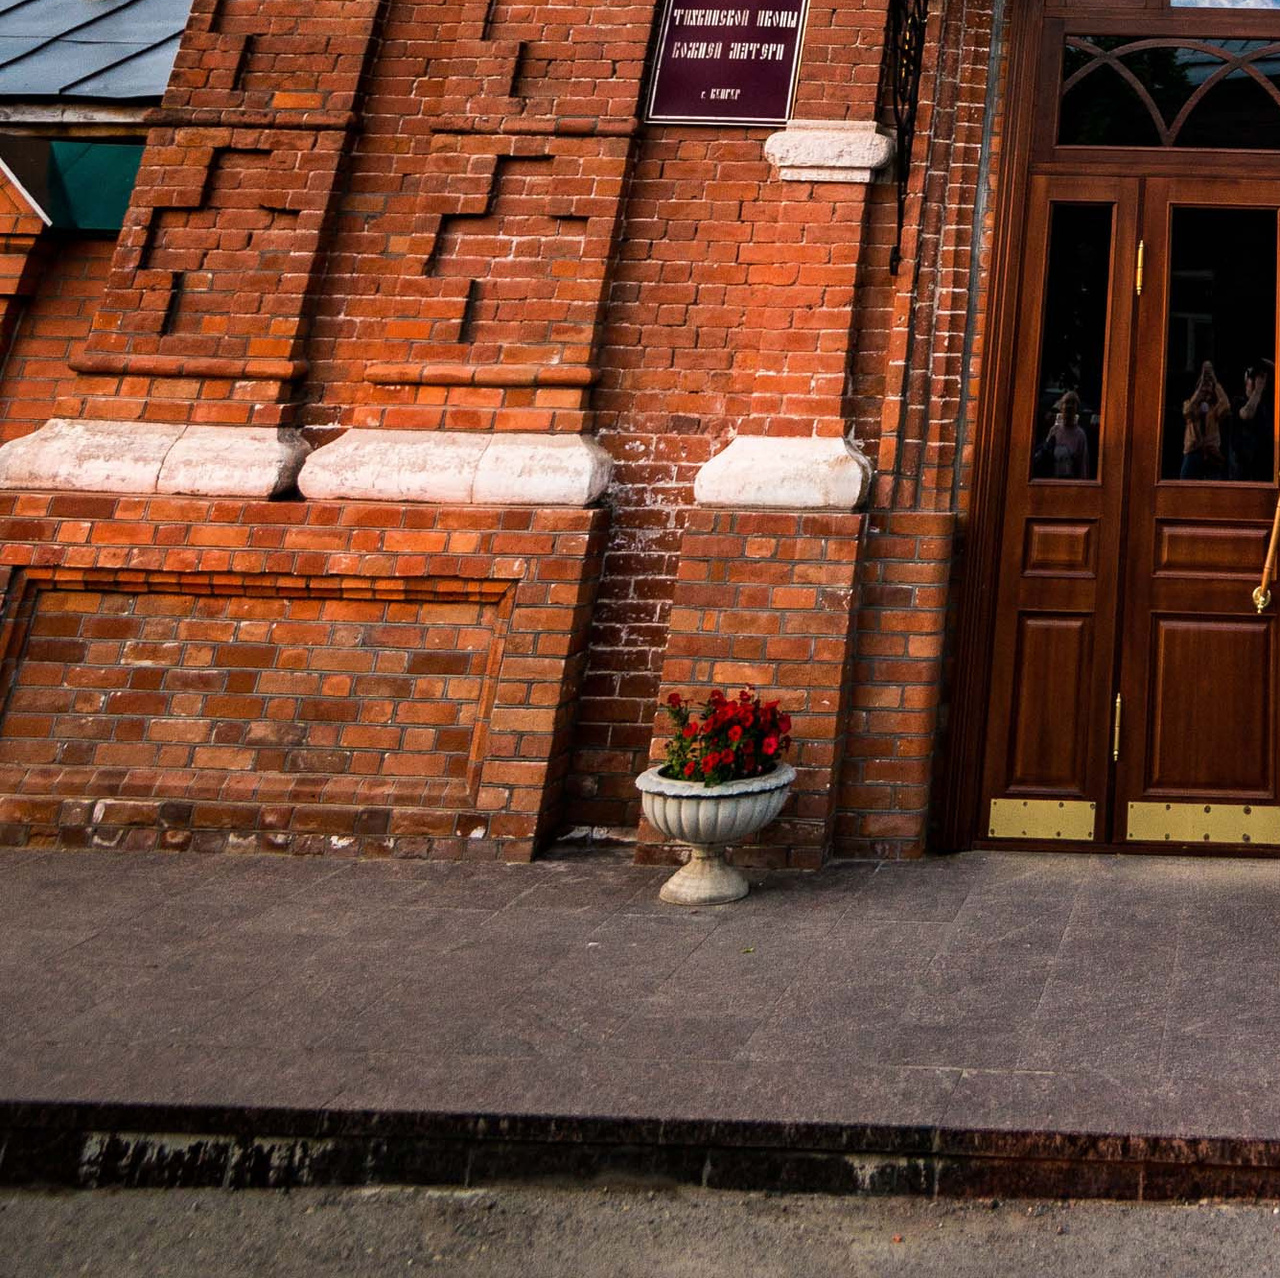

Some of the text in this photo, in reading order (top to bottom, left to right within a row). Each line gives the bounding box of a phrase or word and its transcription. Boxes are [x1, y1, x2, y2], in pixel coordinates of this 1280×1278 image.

[673, 8, 799, 28] ТИХВИНСКОЙ ИКОНЫ
[671, 41, 785, 61] БОЖИЕЙ МАТЕРИ
